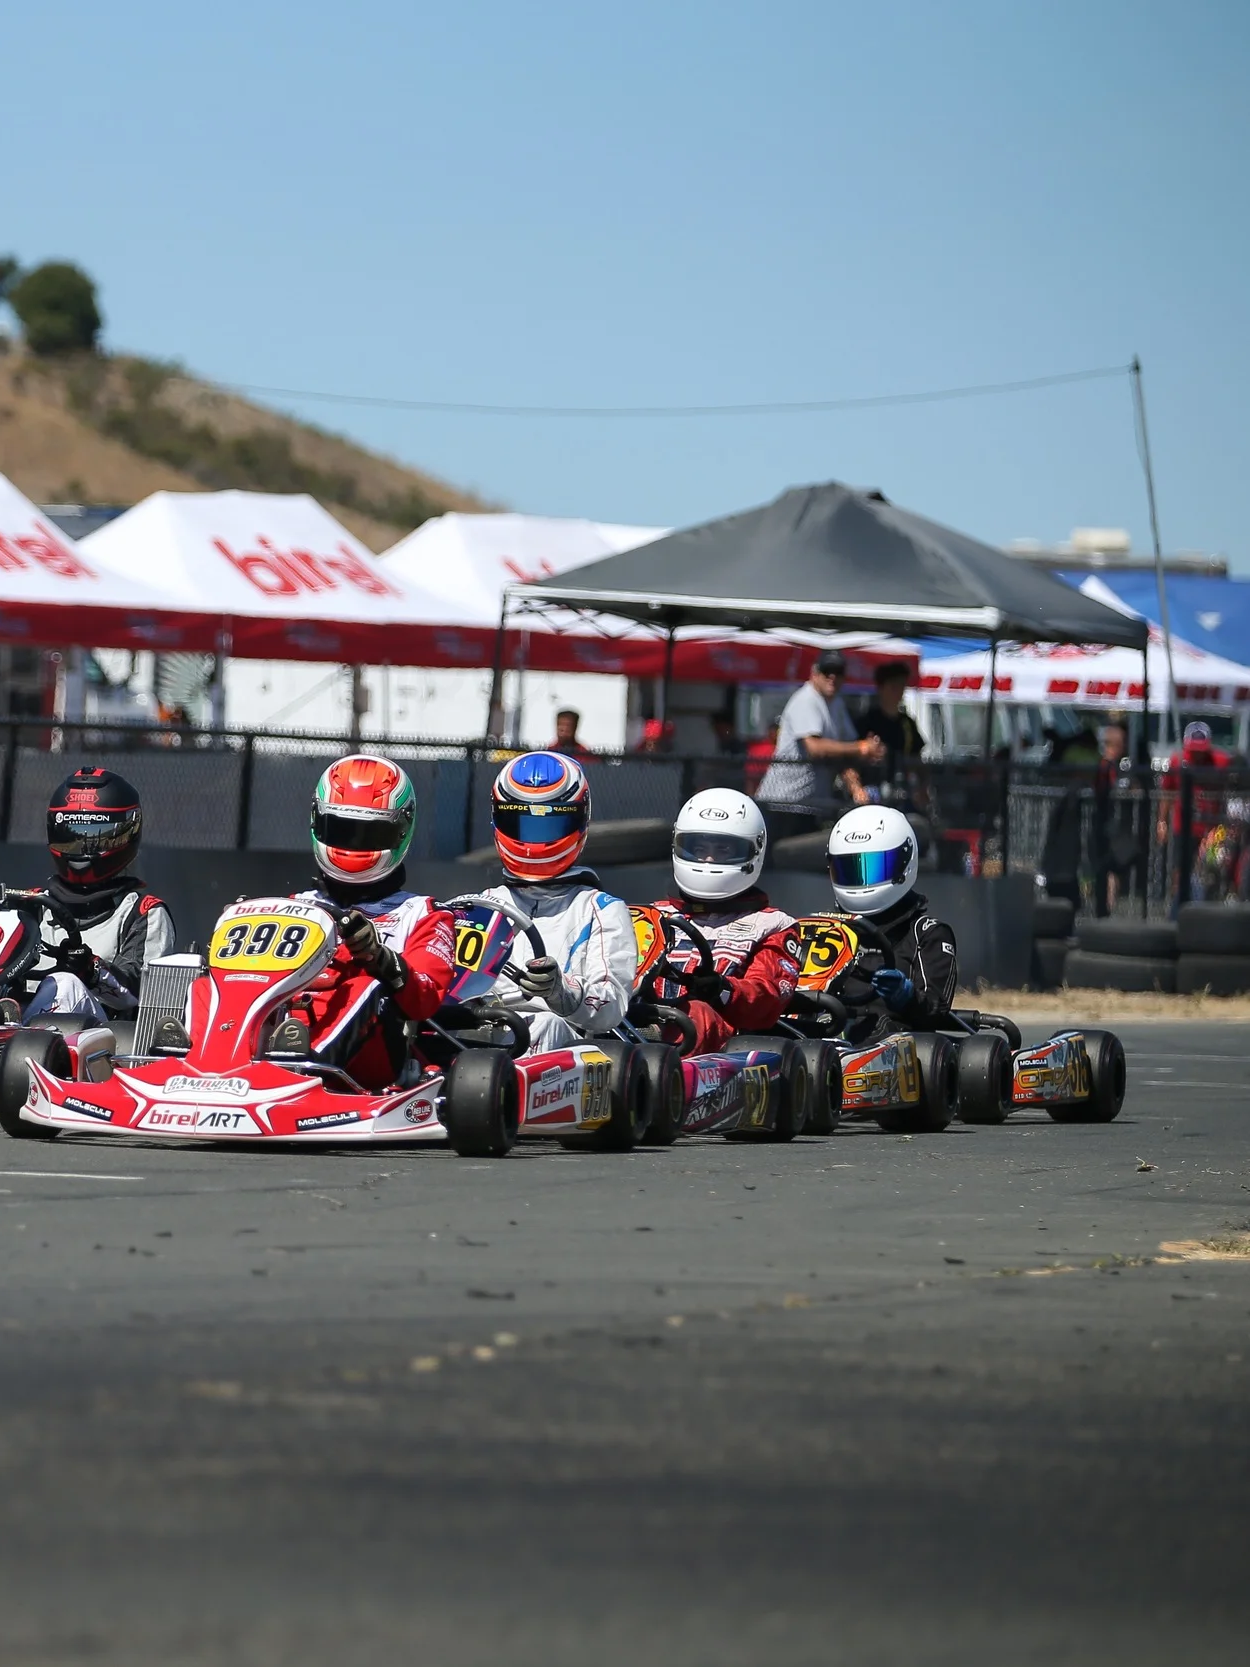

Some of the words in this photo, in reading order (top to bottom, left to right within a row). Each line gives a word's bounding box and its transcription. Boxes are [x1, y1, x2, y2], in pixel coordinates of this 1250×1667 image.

[69, 794, 94, 802] SHOEI
[63, 814, 109, 822] CAMERON
[848, 832, 869, 840] Arai
[235, 904, 315, 916] birelART
[216, 923, 310, 959] 398
[170, 1078, 245, 1090] CAMBRIAN
[532, 1077, 580, 1110] birelART
[66, 1097, 112, 1118] MOLECULE
[148, 1110, 247, 1128] birelART
[298, 1111, 358, 1127] MOLECULE
